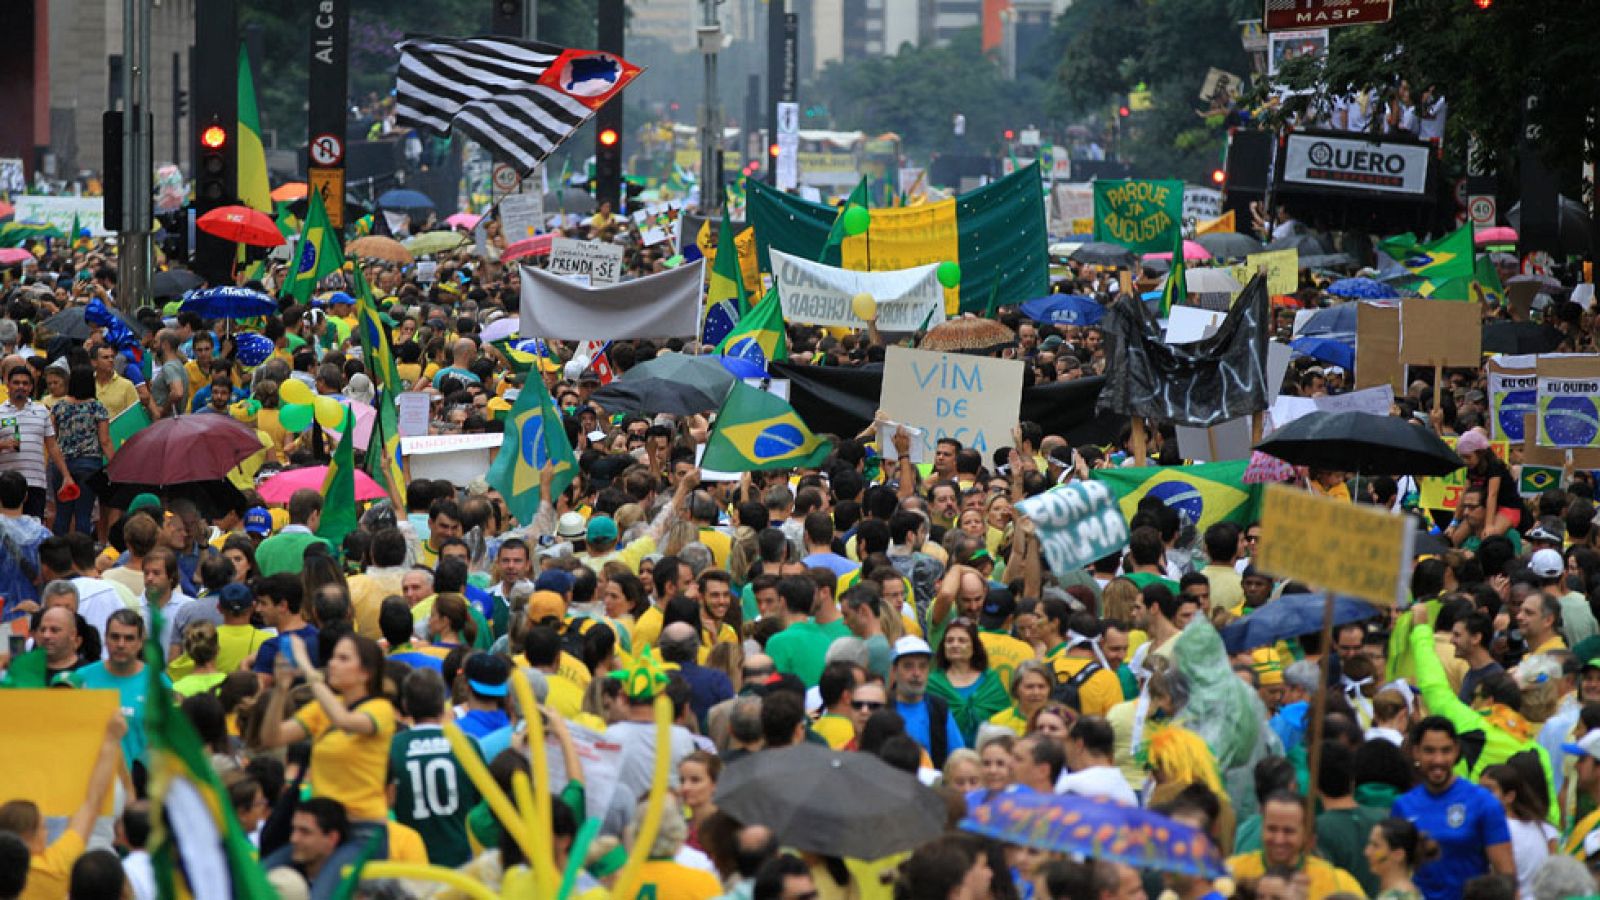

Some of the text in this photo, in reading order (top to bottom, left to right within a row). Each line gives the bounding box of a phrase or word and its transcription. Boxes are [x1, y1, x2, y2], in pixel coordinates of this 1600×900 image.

[1296, 9, 1361, 22] MASP
[1308, 141, 1406, 175] QUERO
[1106, 182, 1170, 208] PARQUE
[1475, 204, 1490, 214] 40
[1104, 211, 1172, 243] AUGUSTA
[1547, 383, 1599, 393] EU QUERO
[936, 397, 969, 418] DE
[406, 758, 459, 819] 10
